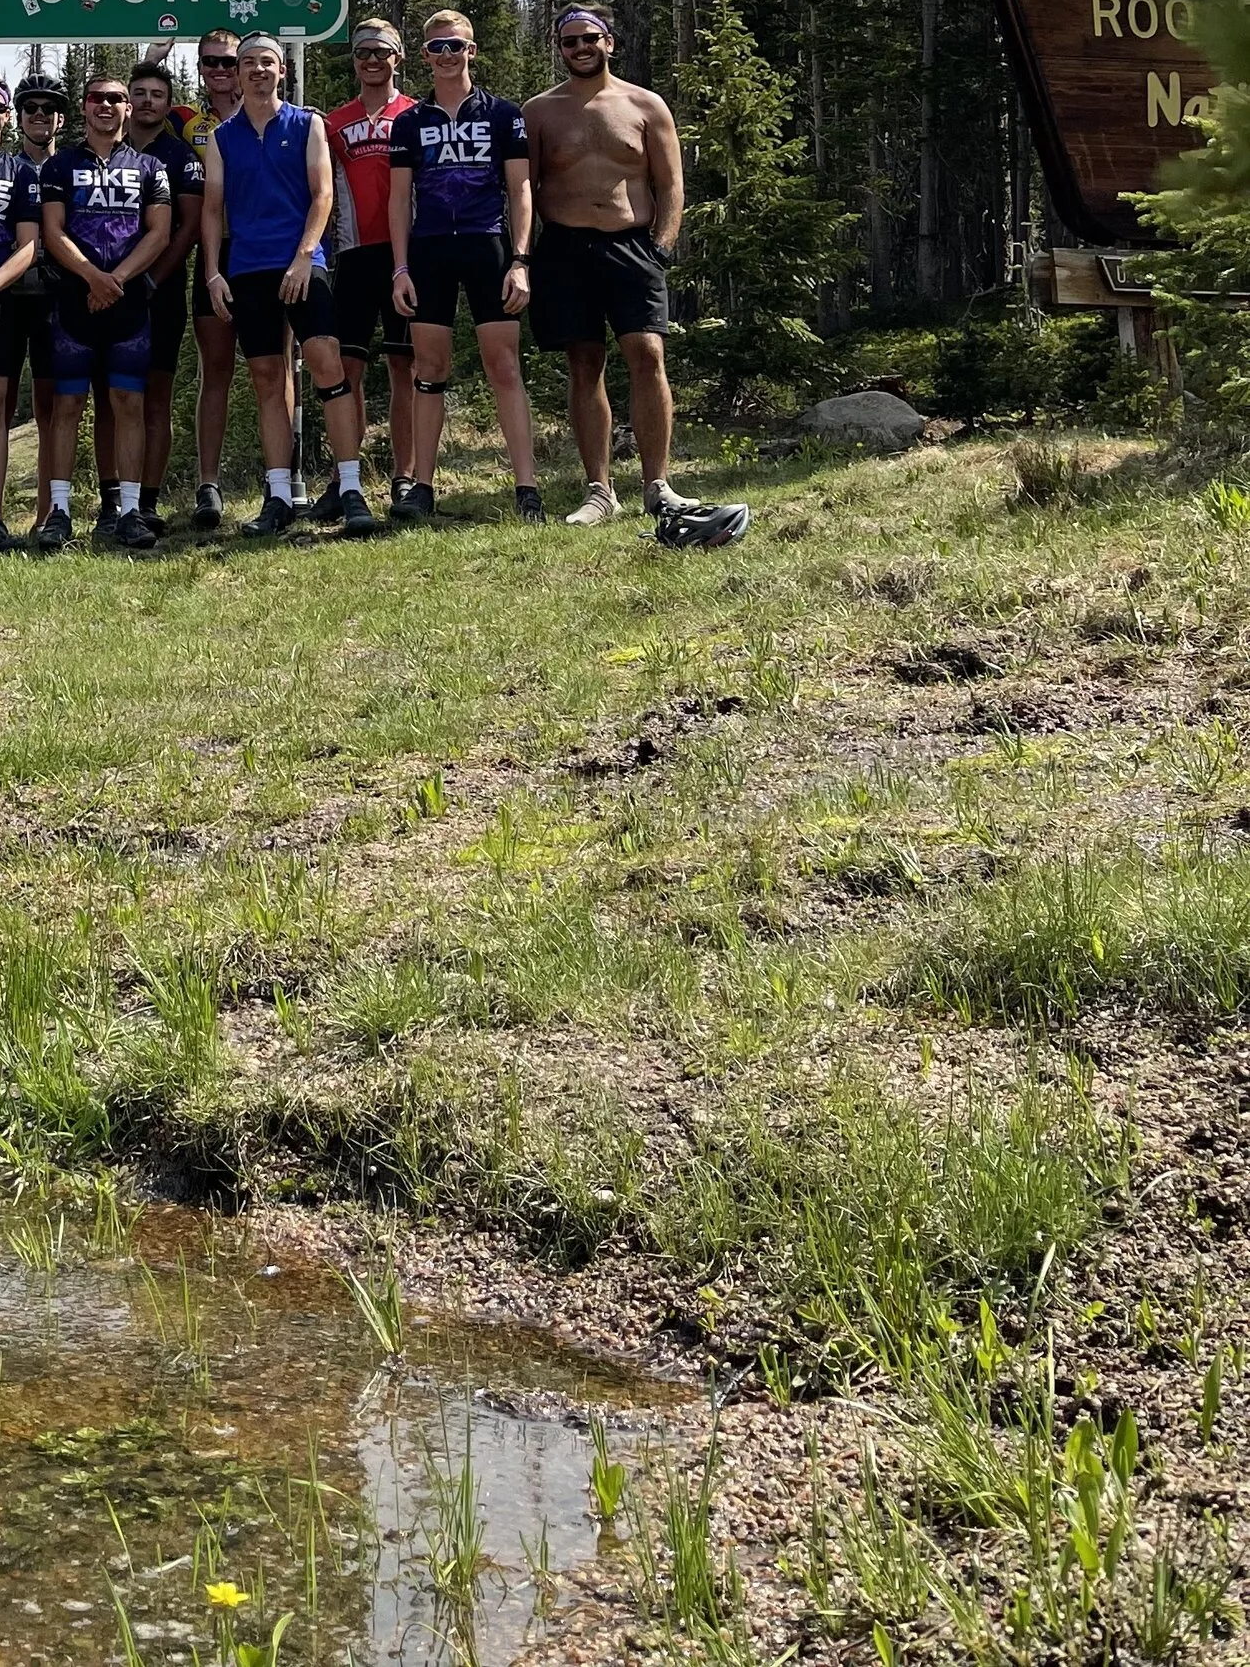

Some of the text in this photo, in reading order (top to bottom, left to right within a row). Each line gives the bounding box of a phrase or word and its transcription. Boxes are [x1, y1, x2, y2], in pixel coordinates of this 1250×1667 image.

[420, 121, 491, 146] BIKE
[437, 142, 491, 164] ALZ
[73, 168, 141, 188] BIKE
[87, 187, 140, 209] ALZ
